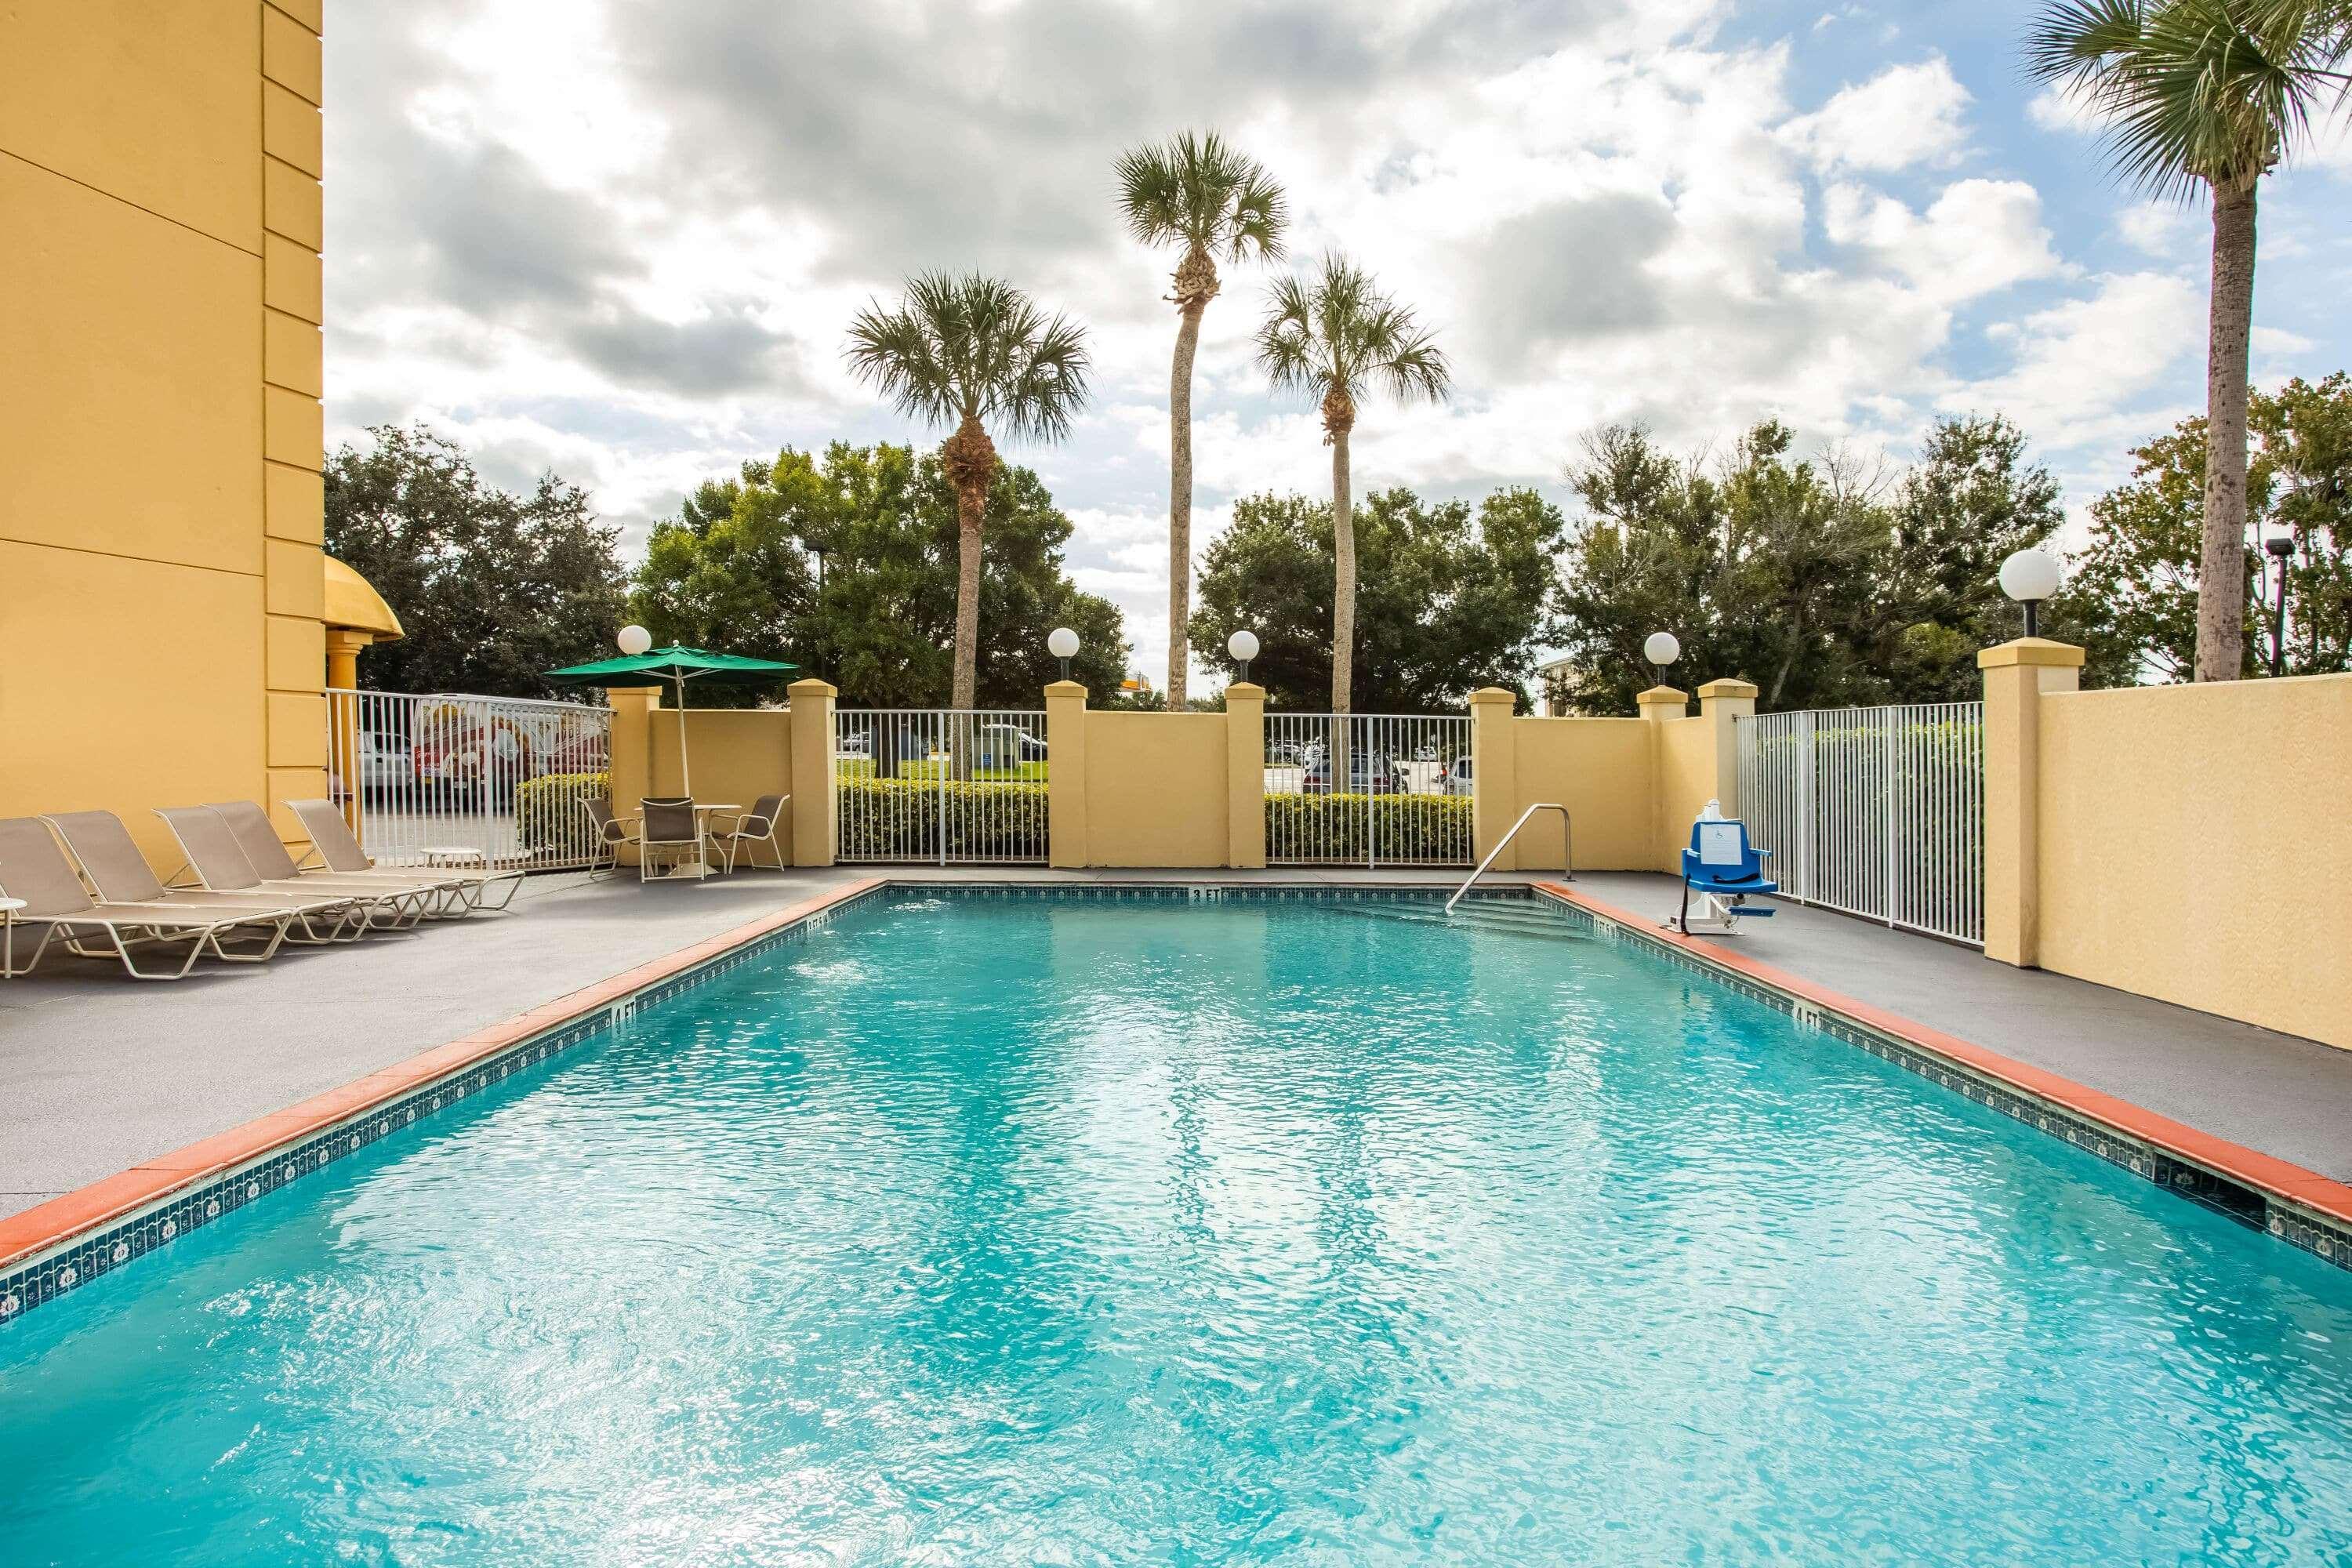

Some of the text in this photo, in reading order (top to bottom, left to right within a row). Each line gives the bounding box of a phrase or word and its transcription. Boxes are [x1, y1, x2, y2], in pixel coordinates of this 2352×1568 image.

[1207, 889, 1220, 899] FT
[625, 1000, 635, 1018] FT
[1806, 1011, 1818, 1027] FT
